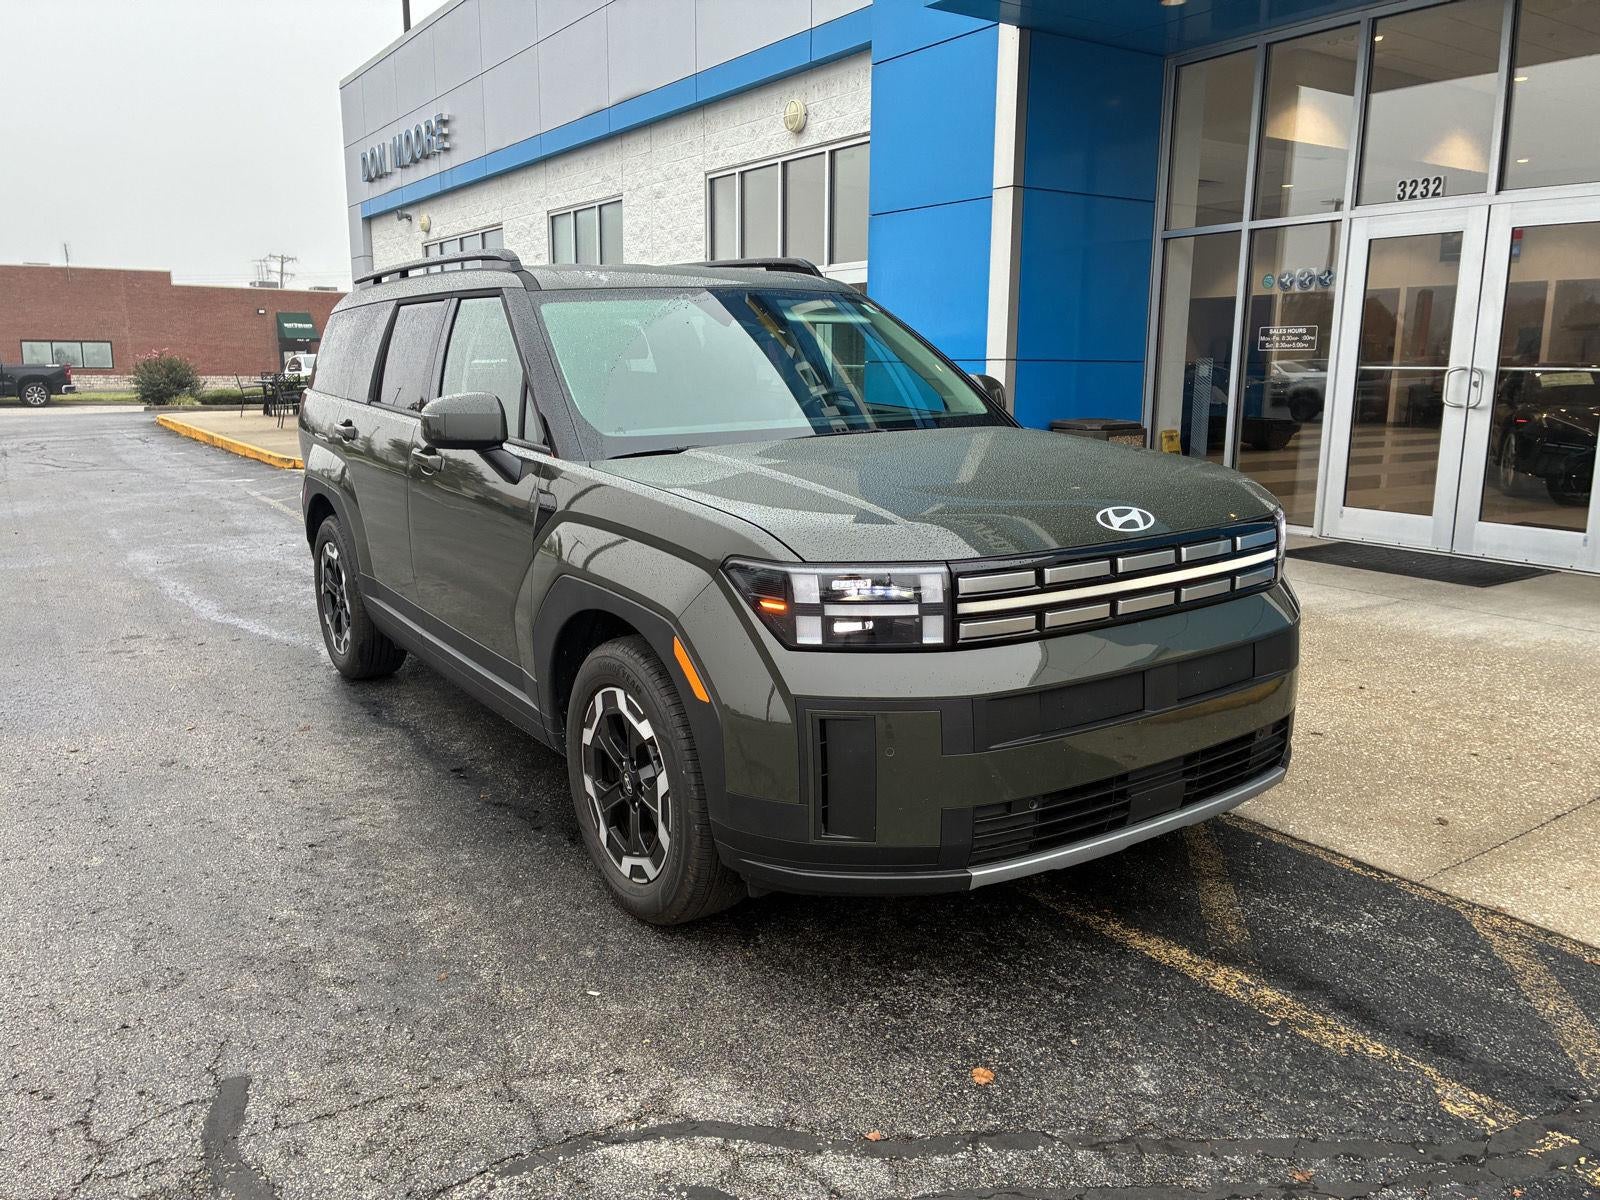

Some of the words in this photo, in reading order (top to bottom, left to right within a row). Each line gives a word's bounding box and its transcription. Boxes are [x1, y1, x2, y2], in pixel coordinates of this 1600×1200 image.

[361, 142, 392, 182] DON
[393, 113, 450, 168] MOORE
[1397, 177, 1442, 200] 3232
